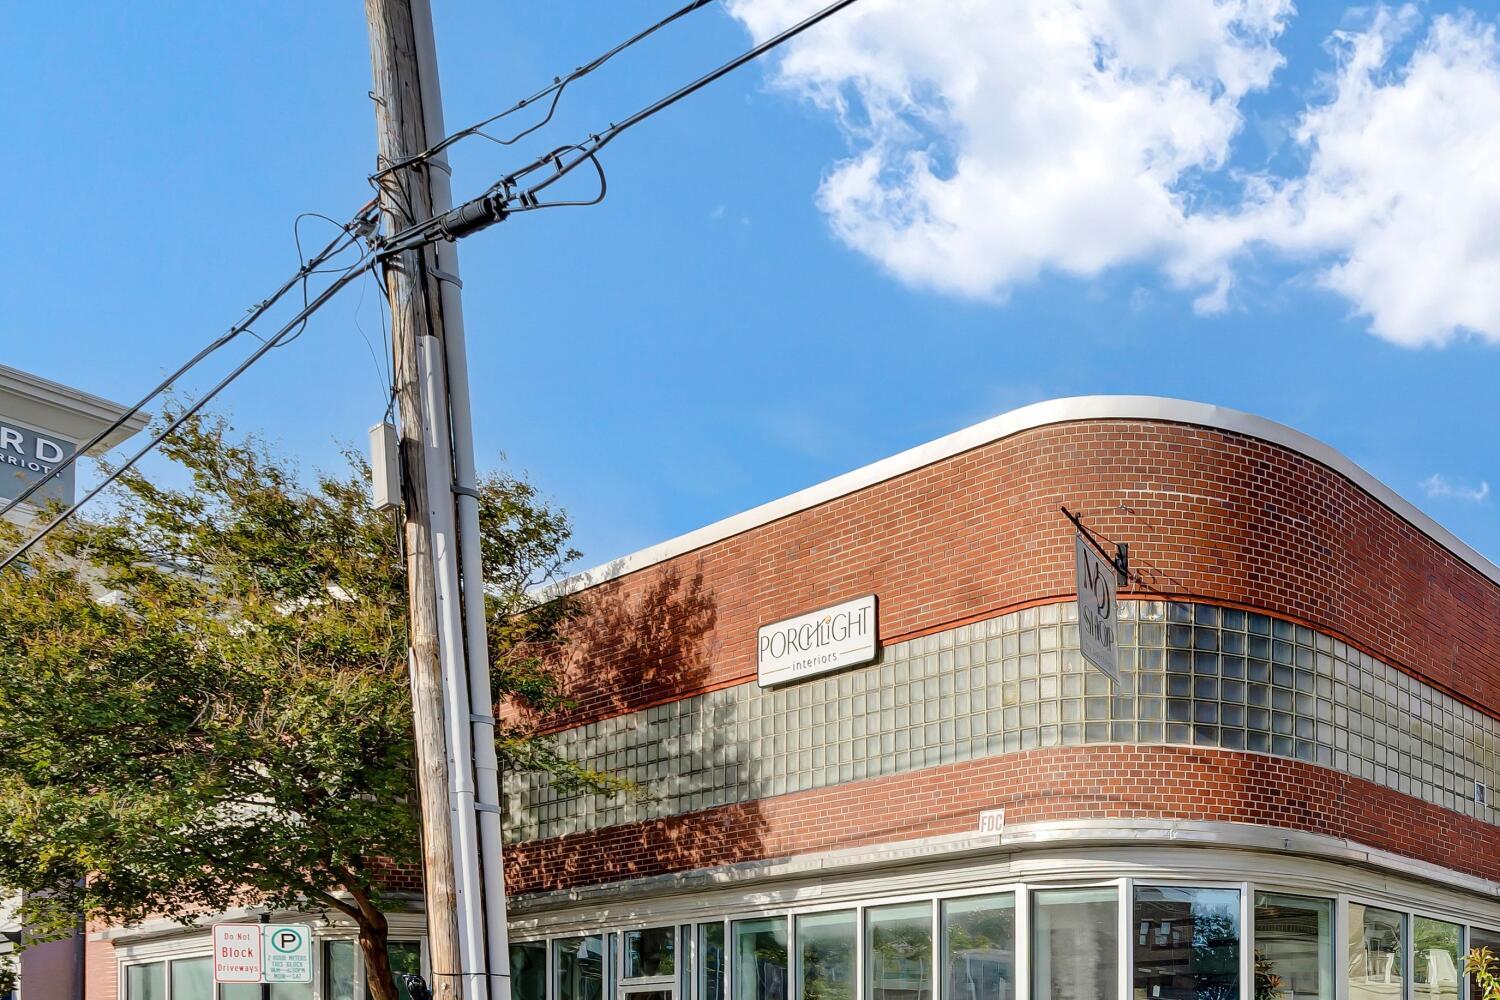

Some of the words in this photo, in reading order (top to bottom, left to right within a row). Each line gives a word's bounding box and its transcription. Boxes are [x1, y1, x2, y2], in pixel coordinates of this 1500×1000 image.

[1084, 604, 1114, 652] SHOP
[792, 652, 838, 672] interiors
[981, 813, 1003, 832] FDC
[224, 932, 234, 941] Do
[237, 932, 250, 941] Not
[280, 933, 296, 949] P
[221, 946, 254, 958] Block
[217, 963, 259, 974] Driveways
